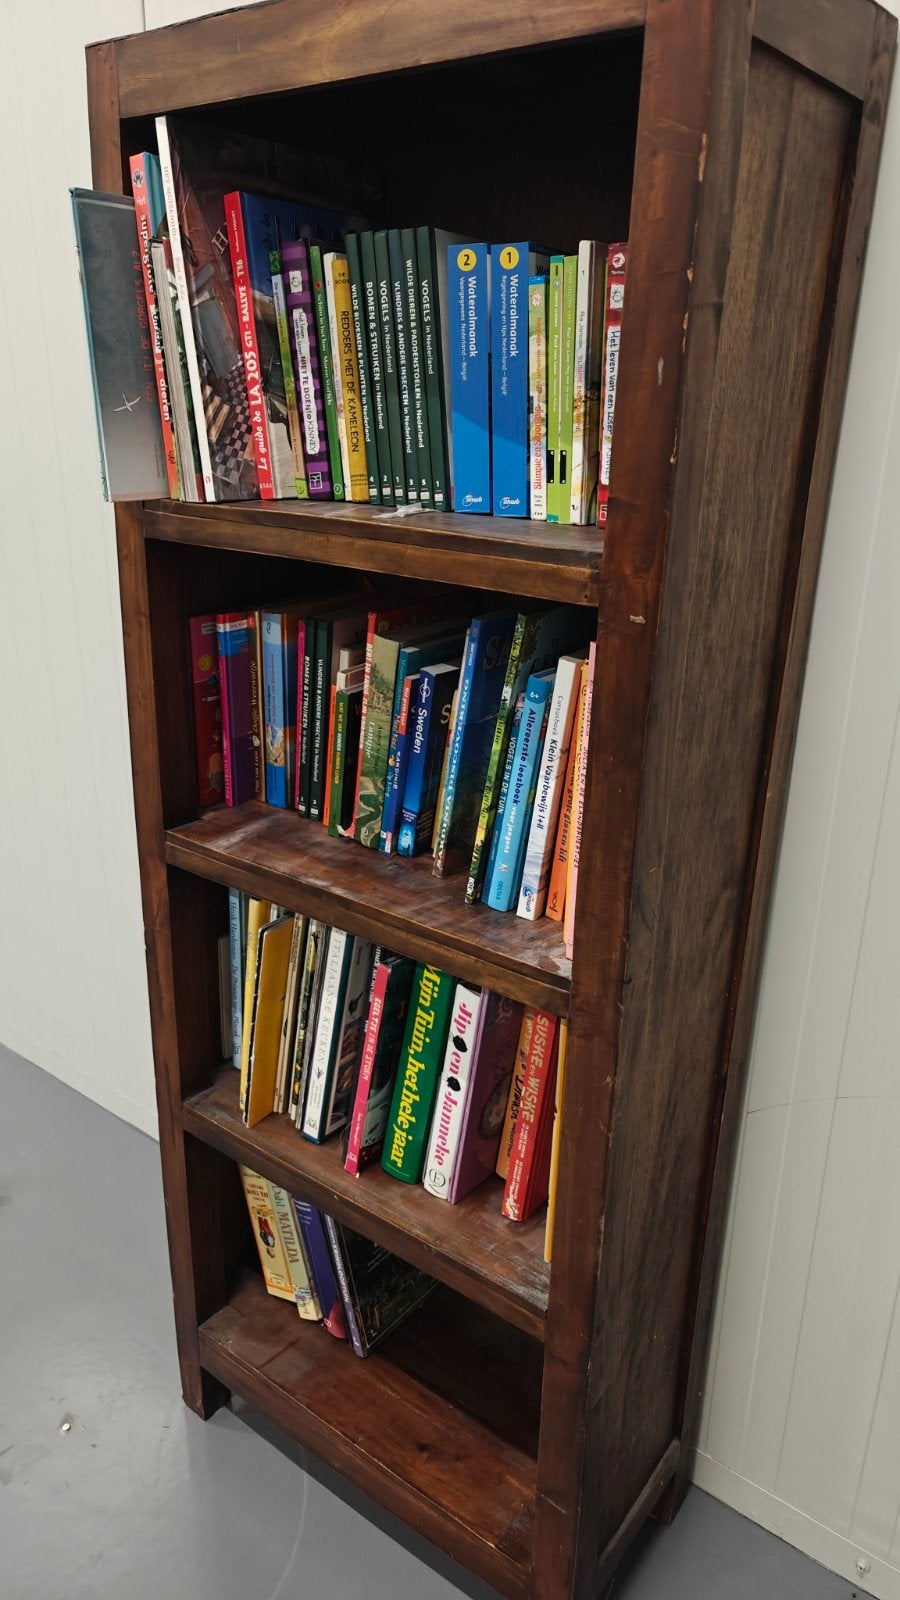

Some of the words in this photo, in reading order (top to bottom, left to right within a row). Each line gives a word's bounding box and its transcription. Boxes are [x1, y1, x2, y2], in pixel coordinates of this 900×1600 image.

[405, 259, 414, 287] WILDE
[463, 253, 470, 267] 2
[506, 251, 512, 264] 1
[134, 278, 147, 328] GORGELS
[238, 284, 250, 322] RALLYE
[350, 283, 358, 311] WILDE
[364, 281, 376, 319] BOMEN
[378, 280, 389, 322] VOGELS
[393, 280, 404, 322] VLINDERS
[407, 288, 416, 320] DIEREN
[419, 279, 431, 322] VOGELS
[499, 275, 507, 314] Regelgeving
[353, 311, 362, 350] BLOEMEN
[369, 321, 375, 330] &
[383, 324, 389, 332] in
[424, 324, 431, 332] in
[467, 276, 478, 357] Wateralmanak
[501, 315, 505, 323] en
[507, 274, 520, 357] Wateralmanak
[140, 335, 149, 349] DE
[243, 329, 252, 348] GTI
[339, 310, 353, 354] REDDERS
[396, 331, 406, 365] ANDERE
[610, 330, 619, 347] Het
[244, 350, 258, 381] 205
[299, 355, 308, 374] NIET
[343, 357, 354, 377] MET
[368, 331, 381, 381] STRUIKEN
[384, 333, 393, 373] Nederland
[409, 328, 422, 399] PADDENSTOELEN
[424, 333, 435, 374] Nederland
[608, 349, 619, 373] leven
[302, 375, 309, 384] TE
[345, 381, 354, 394] DE
[357, 359, 366, 395] PLANTEN
[374, 382, 381, 391] in
[399, 366, 409, 405] INSECTEN
[607, 373, 615, 391] van
[159, 378, 171, 421] dieren
[248, 384, 261, 405] LA
[362, 396, 367, 404] in
[374, 391, 385, 429] Nederland
[403, 406, 409, 414] in
[252, 409, 261, 422] de
[346, 397, 359, 452] KAMELEON
[361, 405, 371, 442] Nederland
[415, 408, 425, 448] Nederland
[253, 425, 266, 453] guide
[307, 420, 317, 452] KINNEY
[402, 415, 413, 453] Nederland
[257, 456, 267, 470] Le
[534, 446, 541, 457] en
[369, 475, 375, 483] 4
[533, 457, 542, 489] Slimpie
[248, 659, 258, 705] Weerwolfje
[364, 662, 371, 672] EN
[303, 683, 308, 691] &
[530, 691, 540, 699] 6+
[250, 707, 258, 732] Dolfje
[301, 692, 309, 728] STRUIKEN
[400, 697, 408, 712] grote
[551, 694, 563, 735] Cursusboek
[391, 713, 401, 733] Mees
[411, 706, 428, 754] Sweden
[446, 677, 470, 791] DISCOVERING
[519, 707, 537, 762] Allereerste
[389, 733, 397, 749] Kees
[504, 736, 517, 770] VOGELS
[545, 737, 558, 763] Klein
[500, 782, 508, 794] DE
[502, 771, 510, 781] IN
[512, 762, 528, 805] leesboek
[536, 763, 554, 813] Vaarbewijs
[579, 786, 585, 797] DE
[580, 771, 586, 784] EN
[497, 794, 506, 814] TUIN
[562, 787, 574, 813] grote
[503, 822, 515, 854] jongens
[558, 813, 571, 845] glazen
[557, 847, 568, 863] lift
[323, 936, 343, 1012] ITALIAANSE
[415, 963, 442, 1007] Mijn
[407, 1006, 434, 1056] Tuin,
[451, 1001, 474, 1035] Jip
[316, 1016, 331, 1064] KEUKEN
[365, 1043, 374, 1054] DE
[367, 1032, 376, 1043] IN
[528, 1014, 551, 1068] SUSKE
[361, 1054, 373, 1081] STORM
[403, 1055, 426, 1091] het
[448, 1050, 463, 1075] en
[396, 1087, 420, 1127] hele
[519, 1076, 540, 1123] WISKE
[431, 1090, 460, 1167] Janneke
[385, 1123, 413, 1168] jaar
[270, 1183, 285, 1209] Dahl
[276, 1209, 300, 1264] MATILDA
[330, 1243, 351, 1304] KRINGLOOPTUIN
